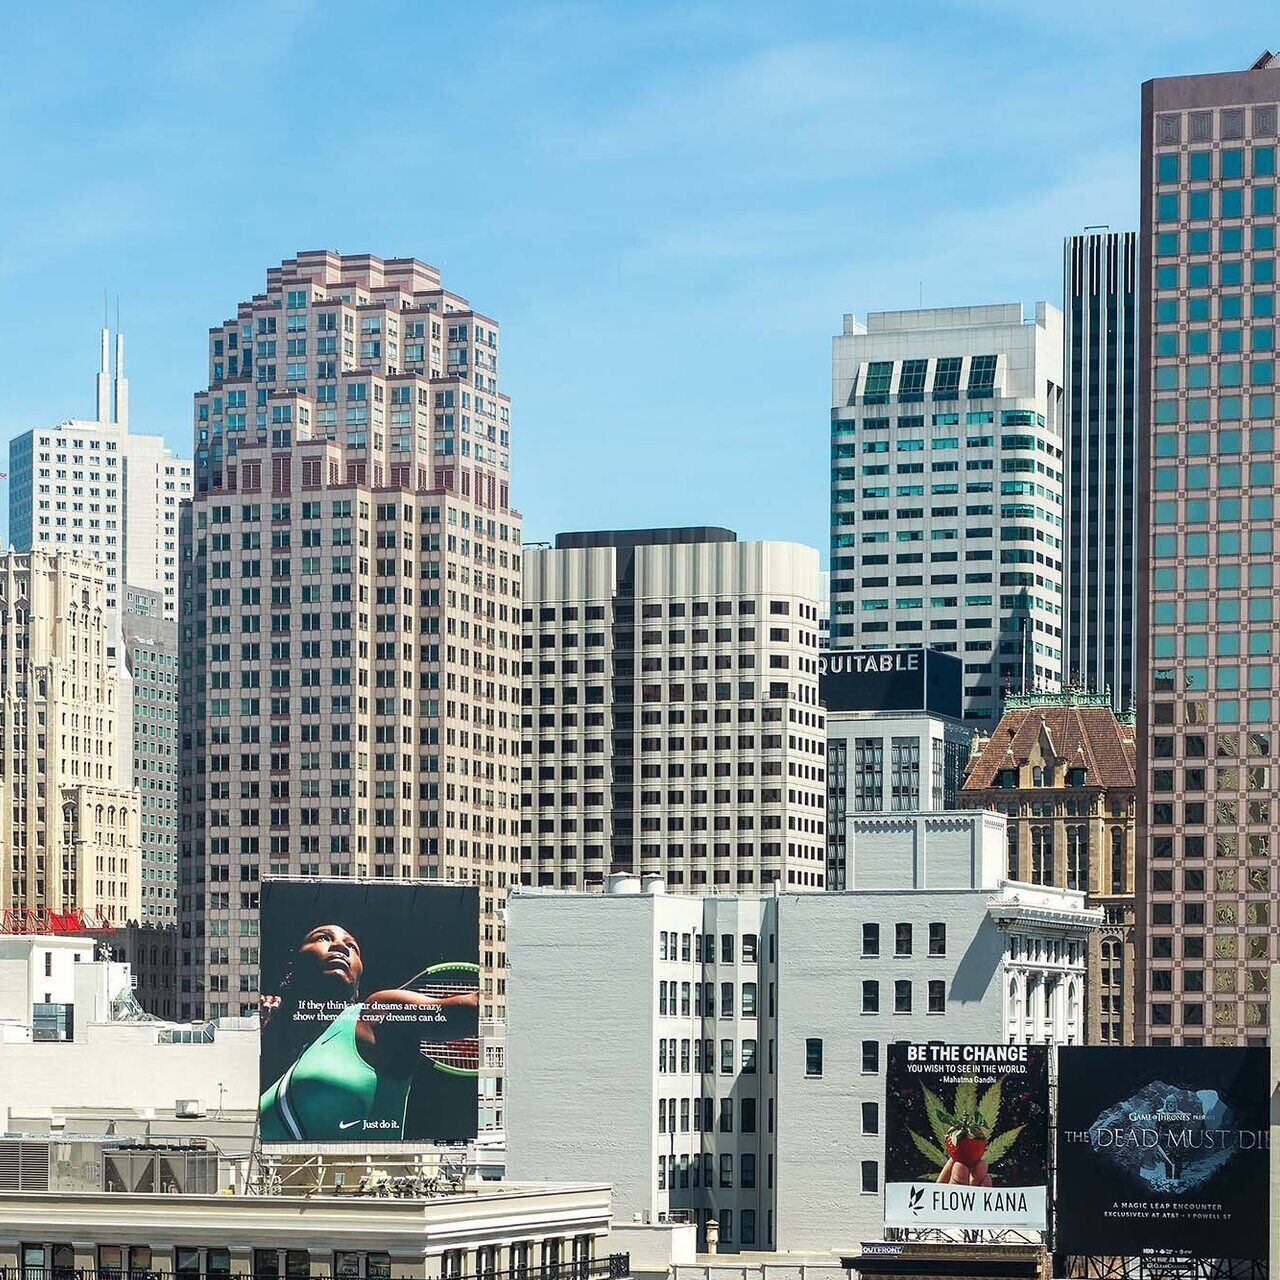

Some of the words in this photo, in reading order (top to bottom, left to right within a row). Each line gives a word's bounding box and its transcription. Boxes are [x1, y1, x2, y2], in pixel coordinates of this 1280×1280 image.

[298, 1000, 307, 1010] If
[307, 1000, 326, 1012] they
[326, 1000, 349, 1010] think
[371, 1001, 403, 1011] dreams
[403, 1003, 417, 1011] are
[418, 1003, 443, 1013] crazy,
[292, 1011, 316, 1021] show
[317, 1011, 338, 1021] them
[362, 1014, 385, 1024] crazy
[385, 1012, 417, 1022] dreams
[418, 1014, 434, 1022] can
[434, 1013, 447, 1022] do.
[907, 1046, 926, 1061] BE
[930, 1046, 959, 1062] THE
[963, 1046, 1028, 1062] CHANGE
[907, 1064, 922, 1073] YOU
[923, 1064, 944, 1073] WISH
[946, 1064, 956, 1073] TO
[957, 1064, 972, 1073] SEE
[972, 1065, 981, 1073] IN
[981, 1065, 996, 1073] THE
[997, 1065, 1028, 1074] WORLD.
[973, 1076, 997, 1084] Gandhi
[363, 1119, 378, 1130] Just
[379, 1119, 391, 1129] do
[391, 1119, 400, 1129] it.
[1064, 1130, 1090, 1143] THE
[1096, 1128, 1159, 1148] DEAD
[1167, 1129, 1231, 1150] MUST
[932, 1191, 976, 1211] FLOW
[983, 1192, 1028, 1212] KANA
[862, 1246, 902, 1254] OUTFRONT
